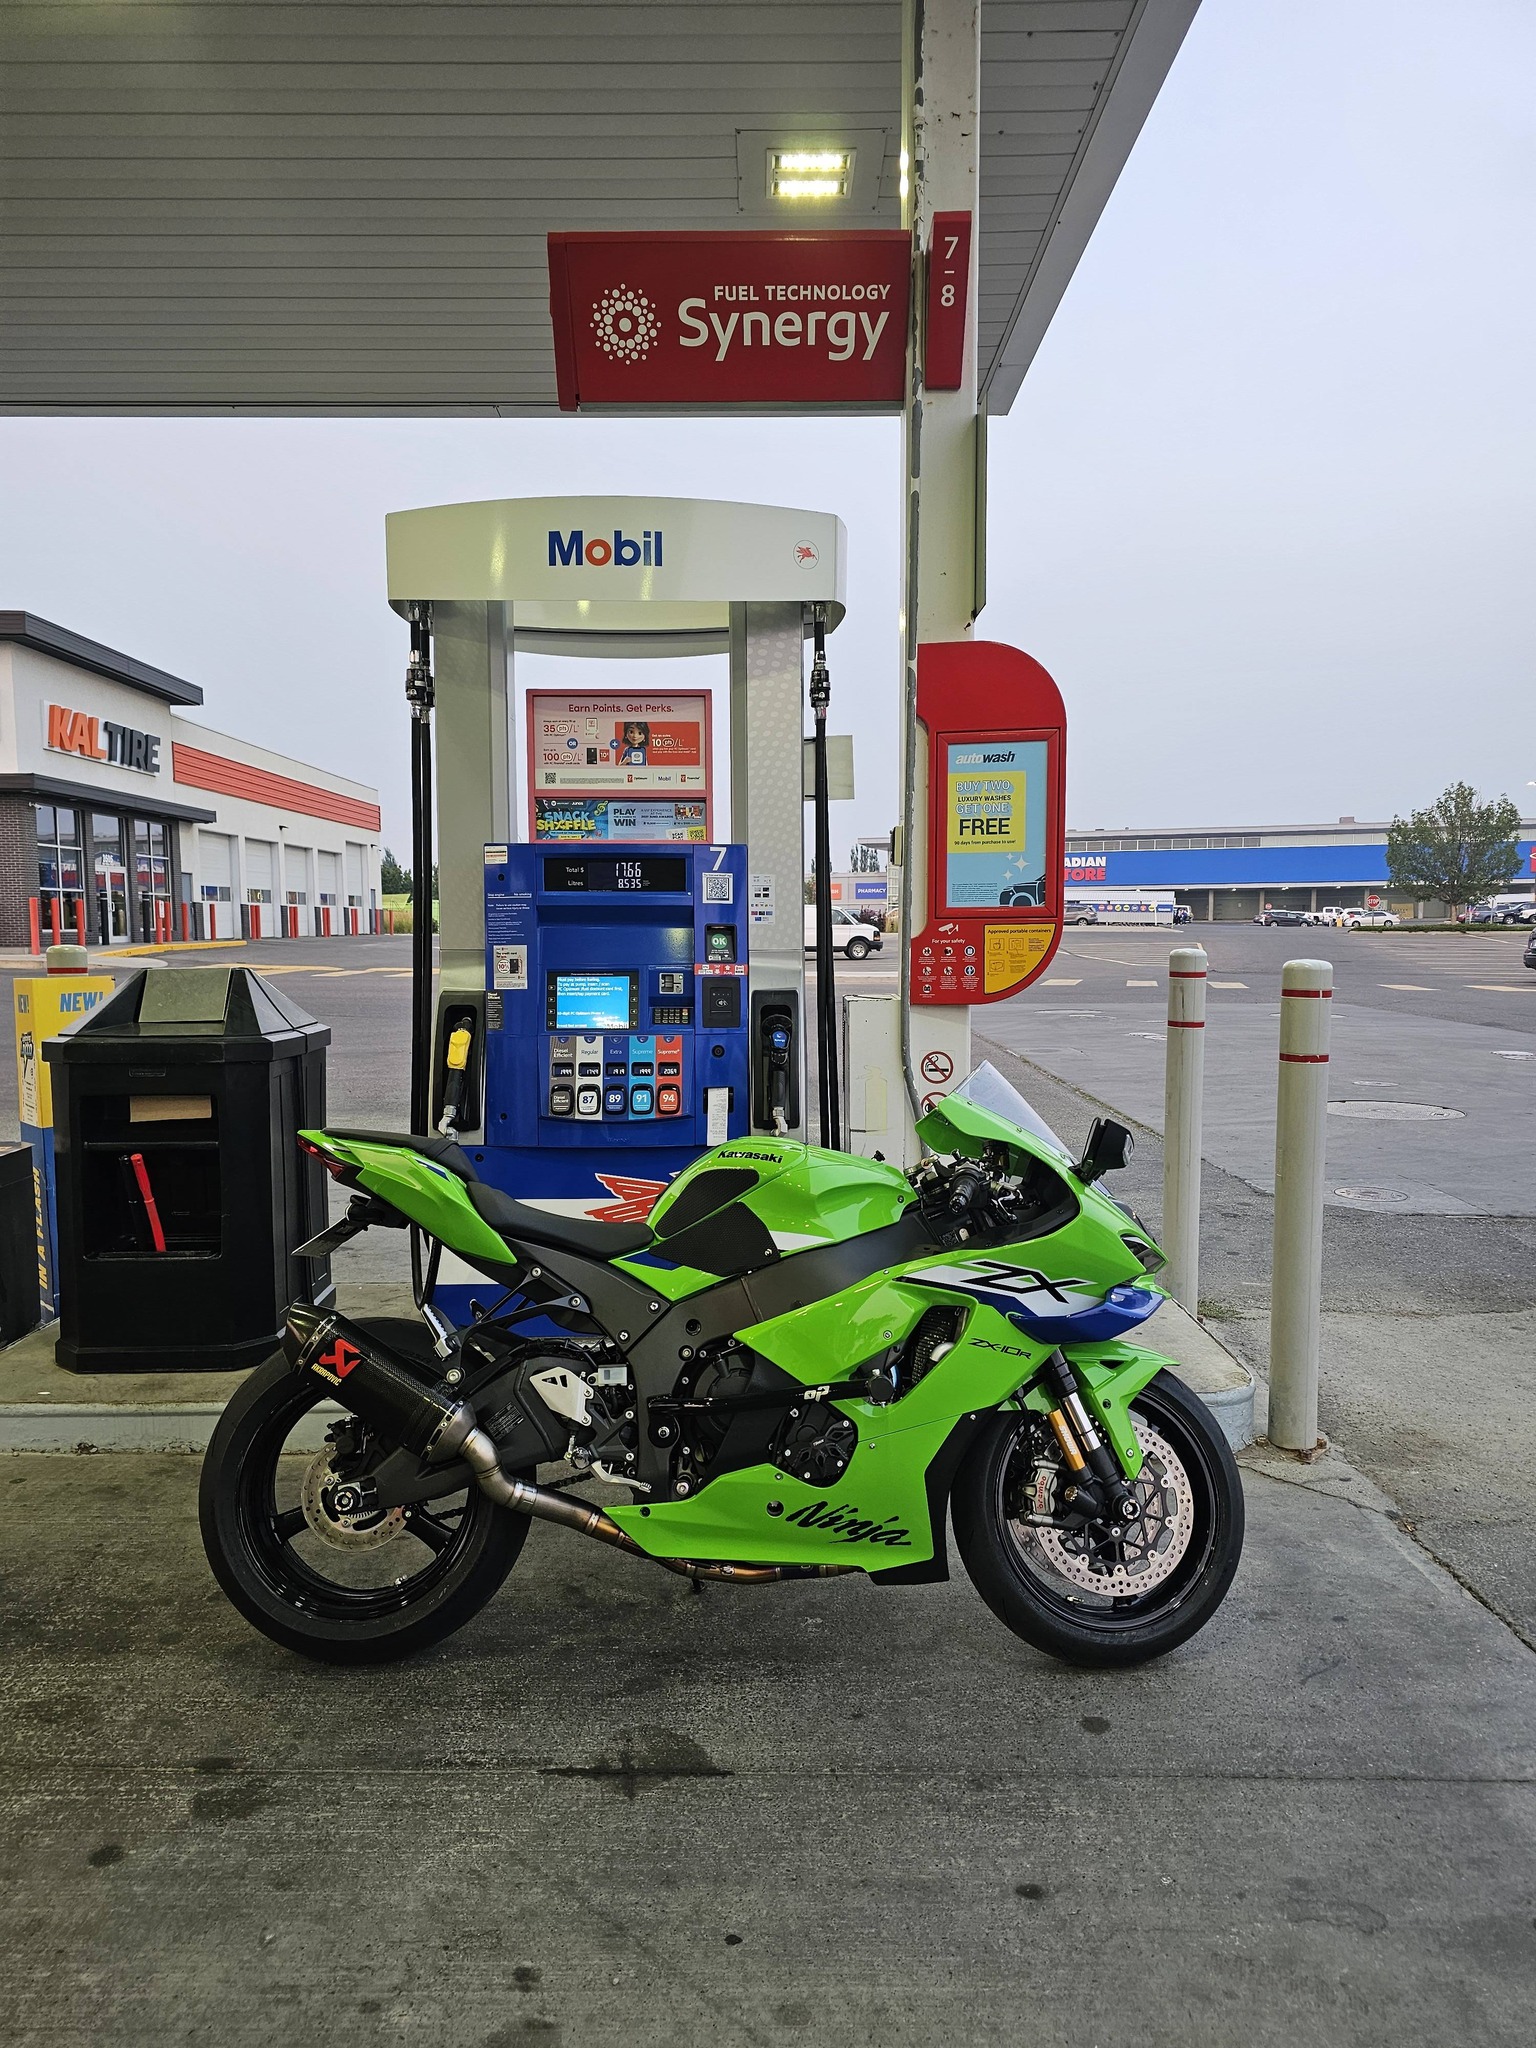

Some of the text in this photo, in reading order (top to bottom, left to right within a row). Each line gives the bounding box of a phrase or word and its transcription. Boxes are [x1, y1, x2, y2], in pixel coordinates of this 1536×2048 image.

[945, 237, 959, 259] 7
[715, 285, 891, 300] FUEL TECHNOLOGY
[941, 285, 955, 307] 8
[677, 298, 890, 361] Synergy
[548, 530, 663, 566] Mobil
[568, 704, 590, 712] Earn
[593, 704, 624, 712] Points.
[543, 725, 556, 733] 35
[48, 705, 160, 773] KAL TIRE
[652, 739, 662, 747] 10
[543, 753, 559, 761] 100
[956, 751, 1016, 765] autowash
[956, 780, 1011, 792] BUY TWO
[956, 802, 1009, 815] GET ONE
[544, 811, 590, 821] SNACK
[959, 818, 1011, 836] FREE
[709, 846, 727, 871] 7
[712, 937, 728, 945] OK
[582, 1095, 594, 1104] 87
[608, 1094, 622, 1103] 89
[636, 1094, 648, 1103] 91
[662, 1094, 675, 1103] 94
[717, 1150, 784, 1164] Kawasaki
[33, 1166, 48, 1290] IN A FLASH
[958, 1260, 1090, 1304] ZX
[967, 1337, 1032, 1360] ZX-10R
[1058, 1425, 1079, 1456] SHOWA
[1036, 1475, 1047, 1509] brembo
[785, 1500, 912, 1546] Ninja
